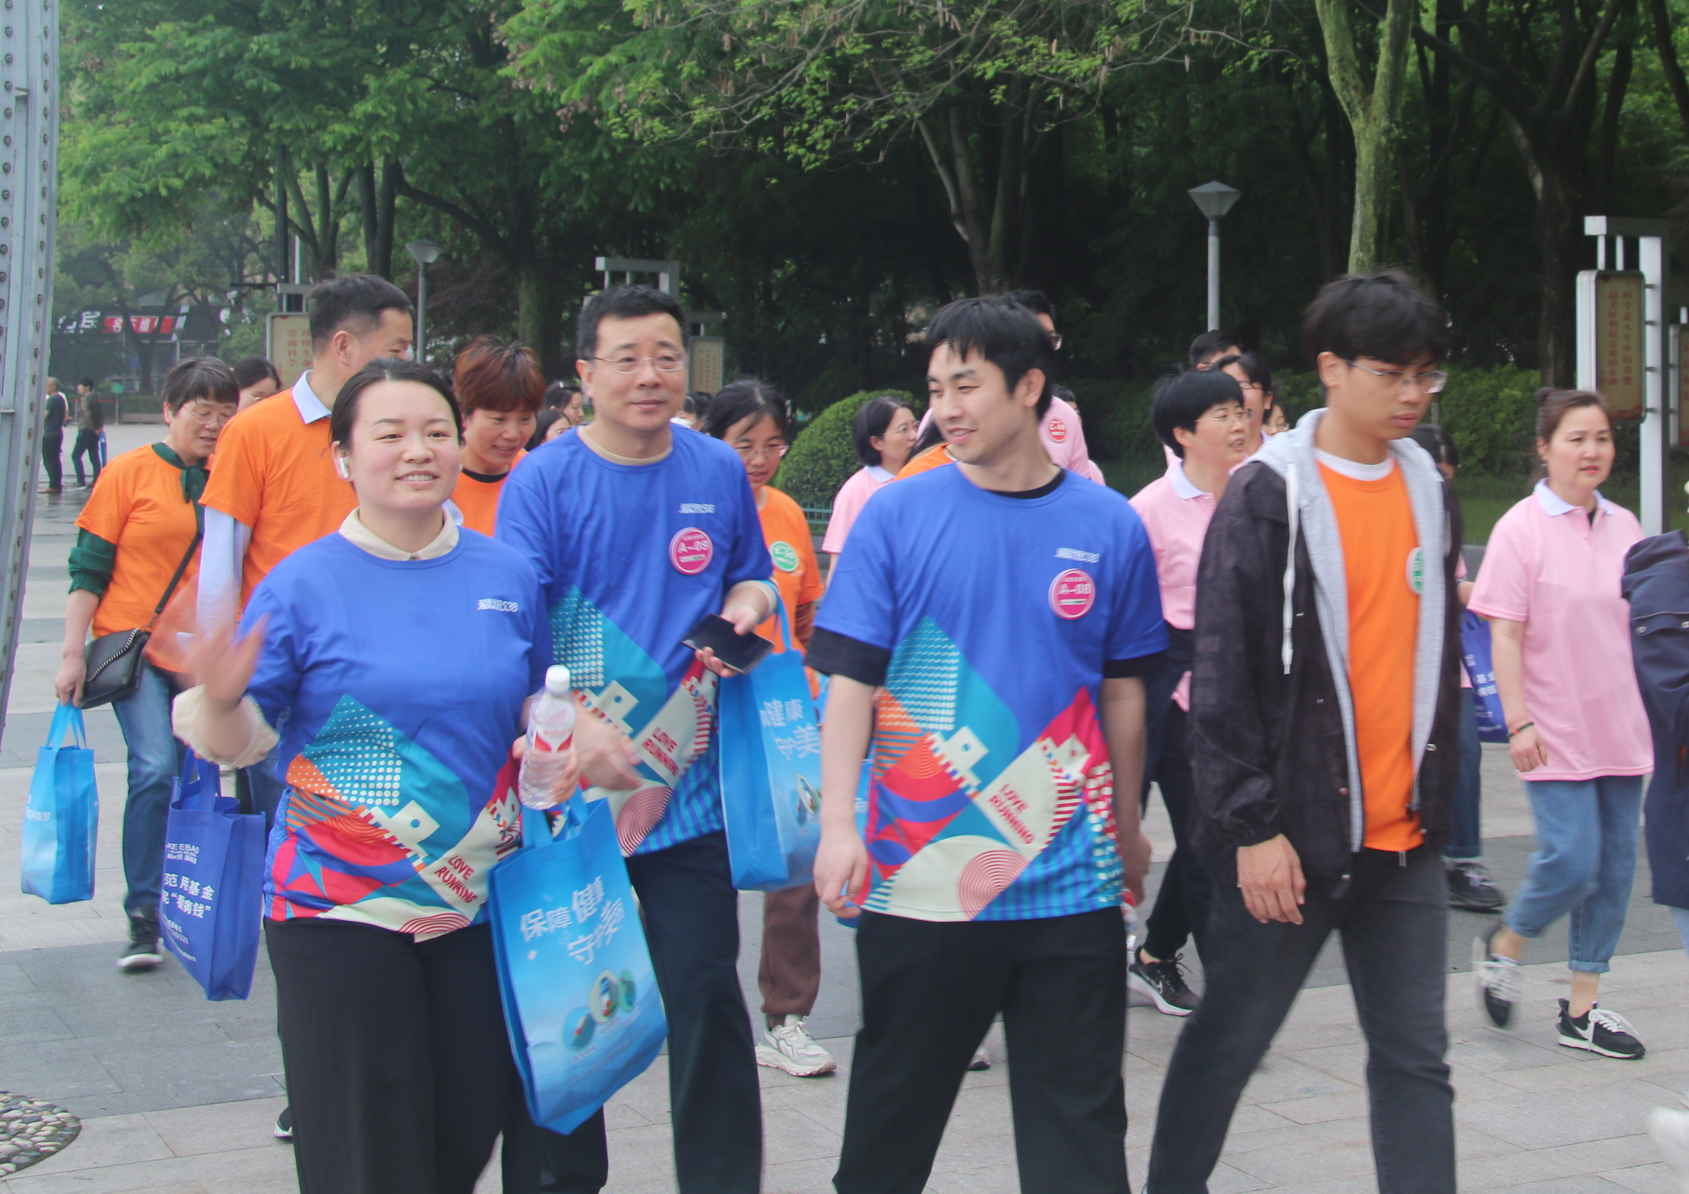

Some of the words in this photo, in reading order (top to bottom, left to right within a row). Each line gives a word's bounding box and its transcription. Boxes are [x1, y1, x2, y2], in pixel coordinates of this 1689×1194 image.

[652, 726, 678, 753] LOVE
[641, 738, 679, 777] RUNNING
[999, 783, 1029, 814] LOVE
[988, 794, 1035, 845] RUNNING
[434, 866, 478, 903] RUNNING
[448, 855, 475, 881] LOVE
